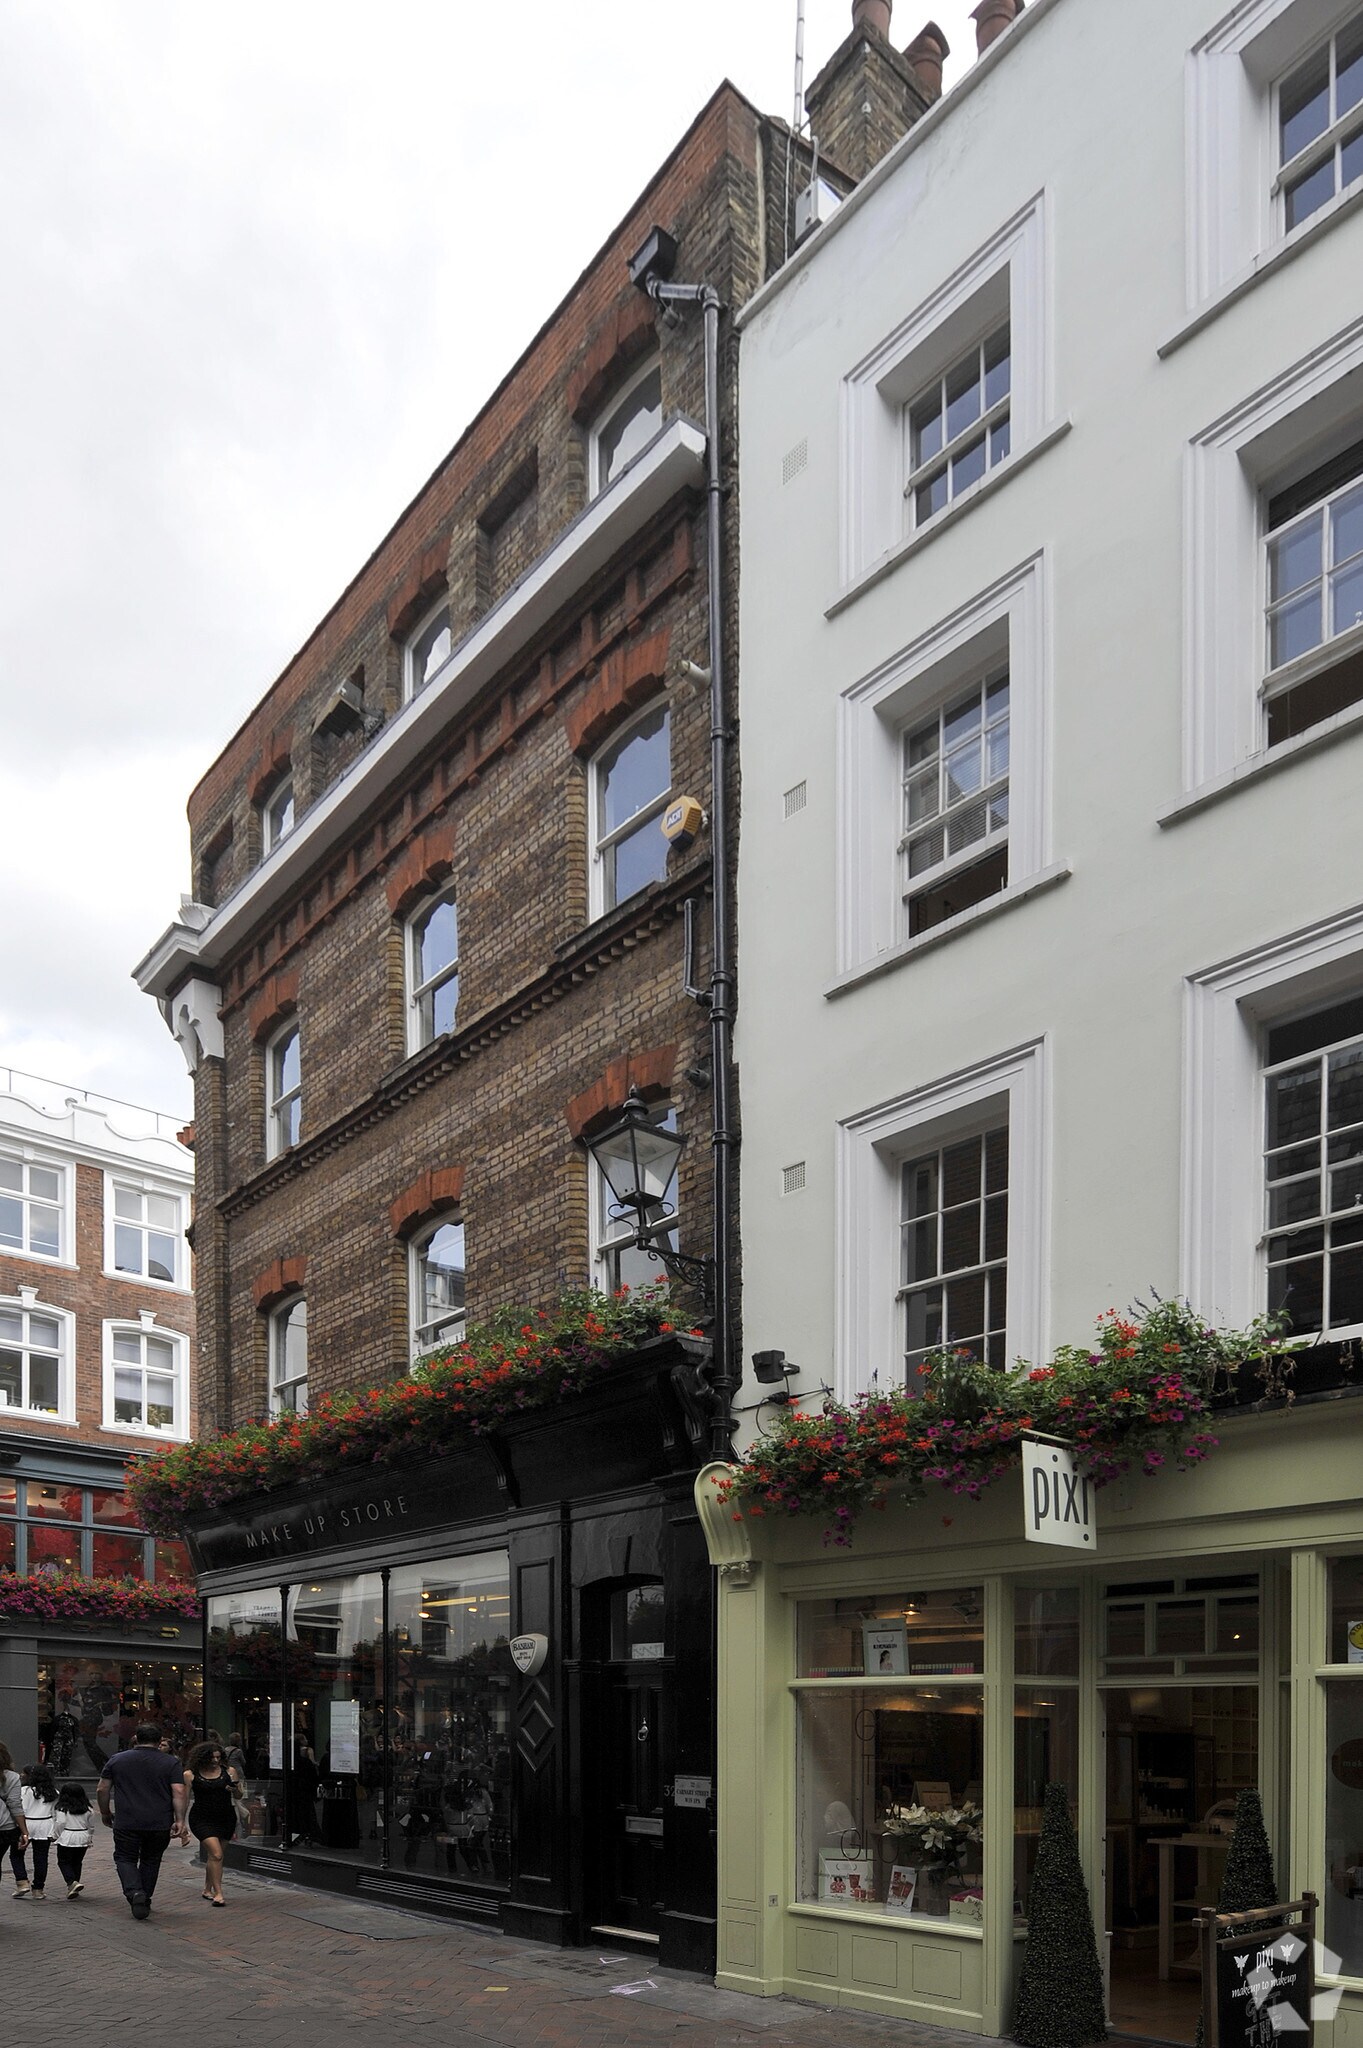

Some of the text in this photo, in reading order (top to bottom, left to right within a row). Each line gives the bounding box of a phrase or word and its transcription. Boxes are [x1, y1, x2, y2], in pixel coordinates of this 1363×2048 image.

[666, 808, 683, 827] ADT
[245, 1495, 408, 1548] MAKE UP STORE
[663, 1785, 675, 1797] 32
[1231, 1970, 1297, 1998] makeup to makeup
